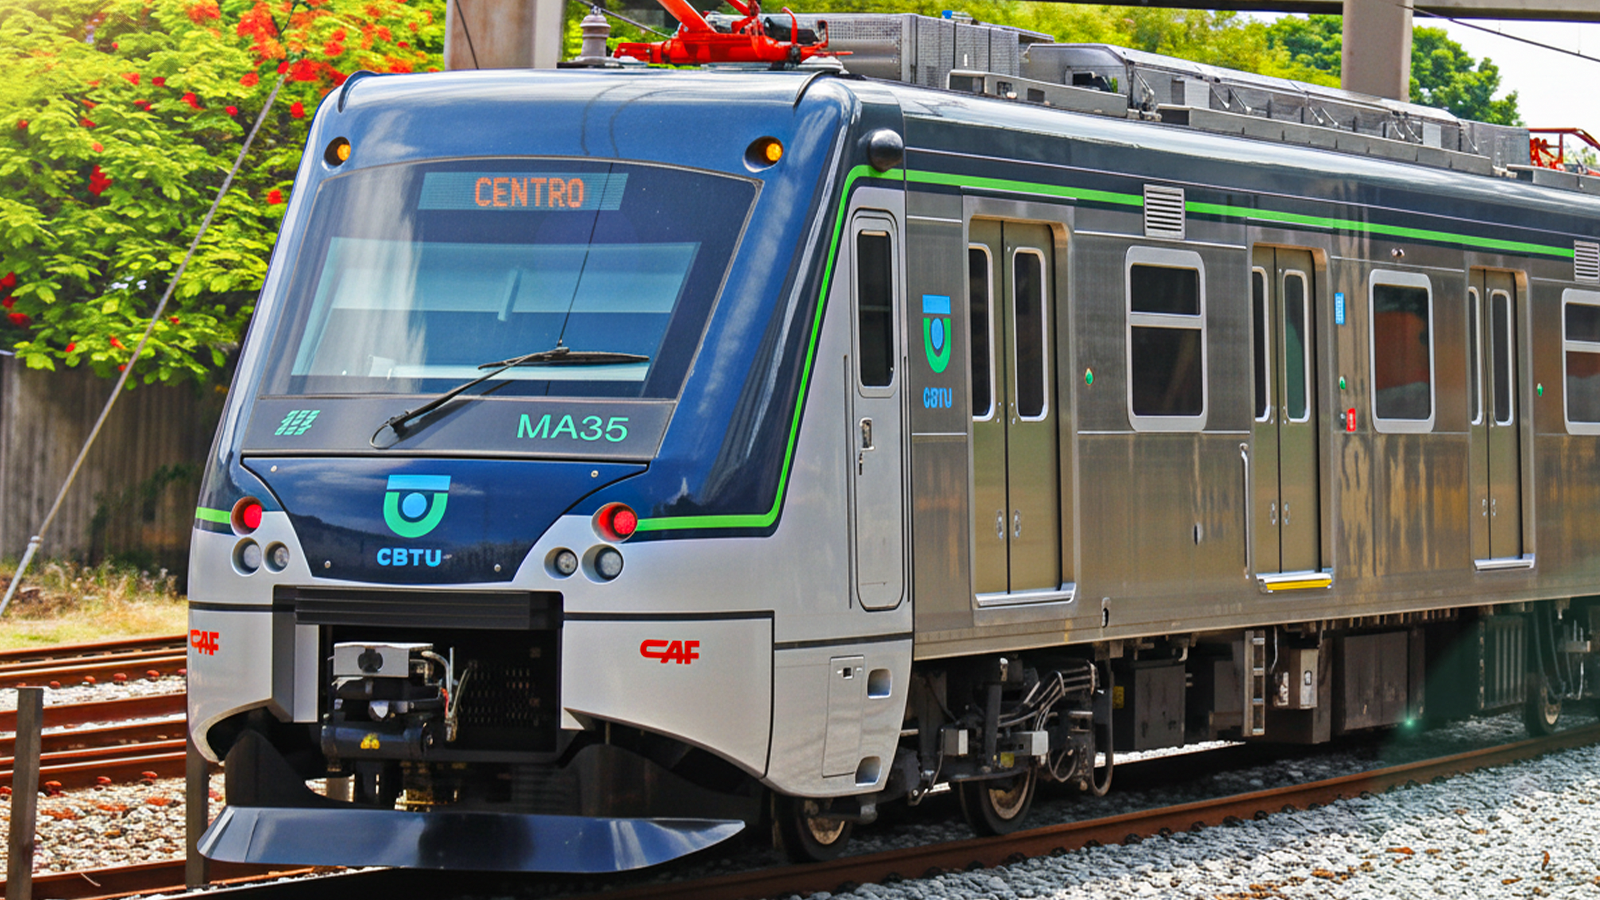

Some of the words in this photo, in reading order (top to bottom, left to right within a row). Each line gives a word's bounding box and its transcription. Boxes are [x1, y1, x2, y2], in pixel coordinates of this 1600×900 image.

[475, 177, 584, 208] CENTRO
[517, 413, 629, 442] MA35
[376, 547, 442, 568] CBTU
[190, 629, 219, 656] CAF
[640, 639, 700, 665] CAF
